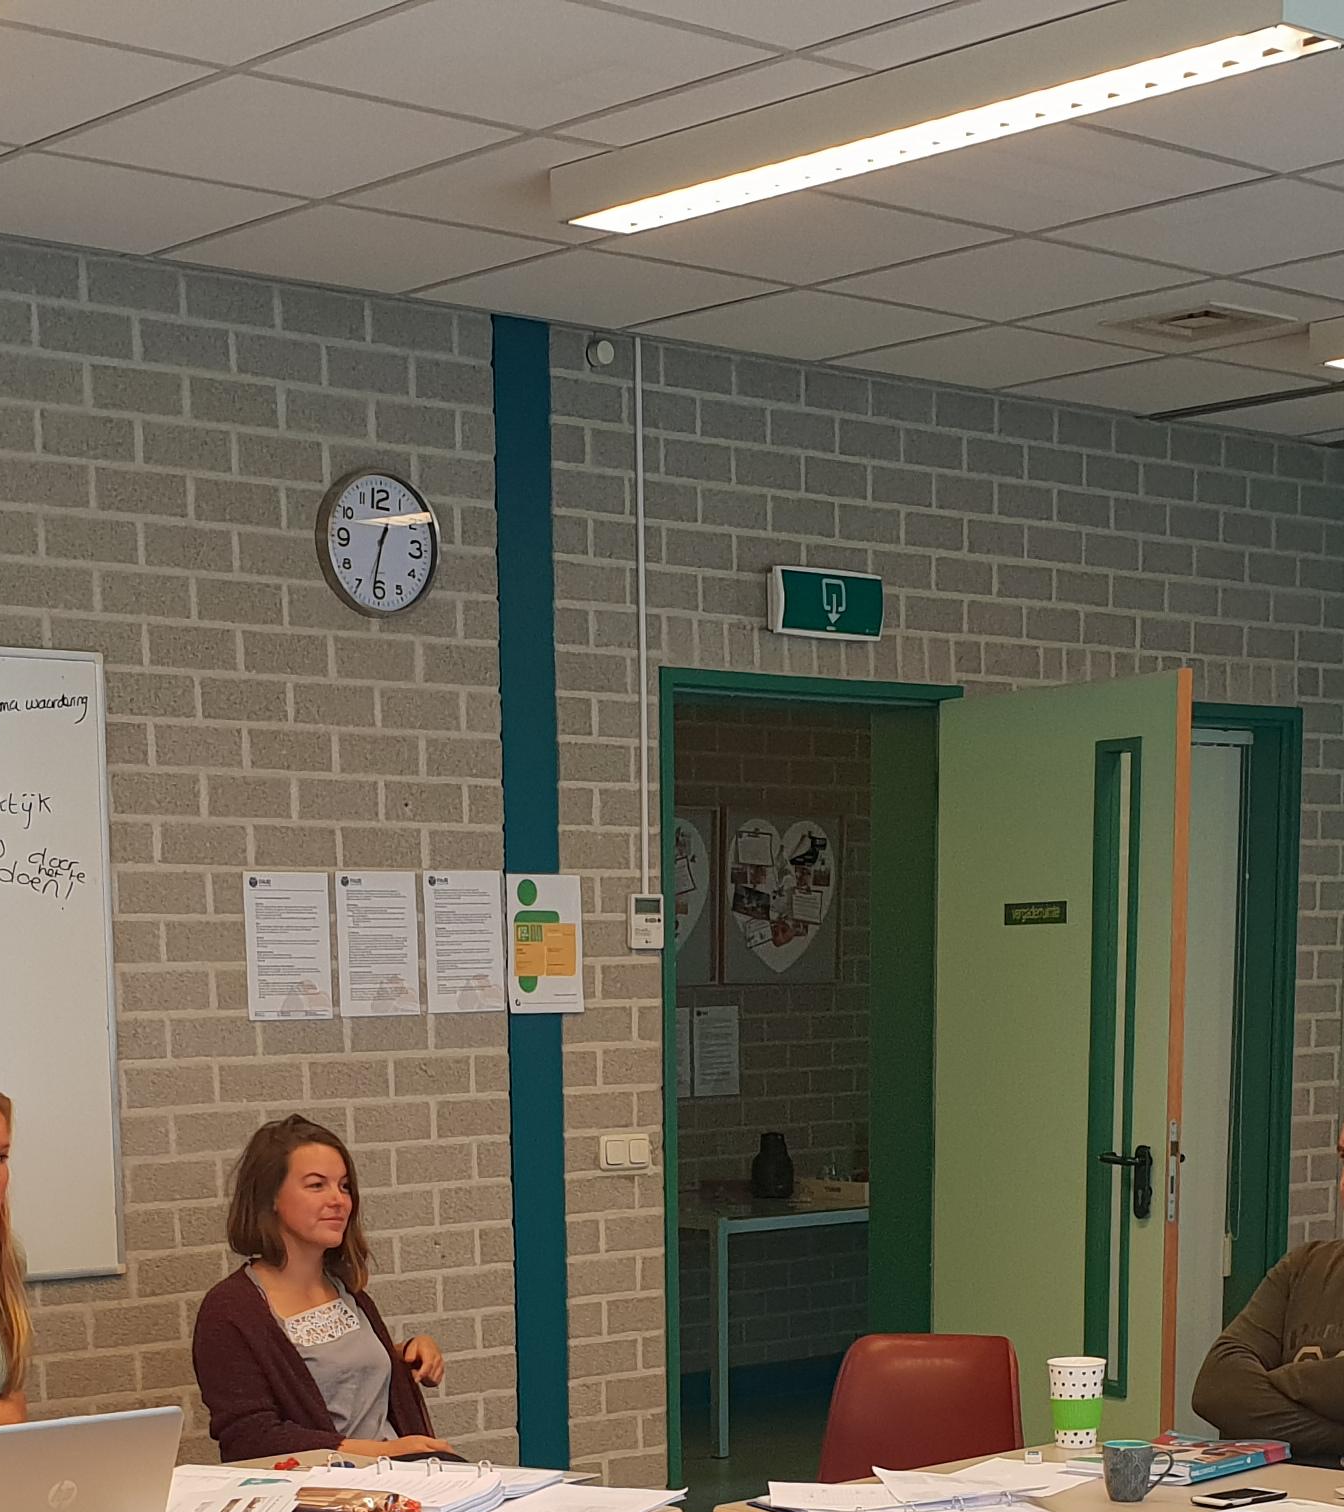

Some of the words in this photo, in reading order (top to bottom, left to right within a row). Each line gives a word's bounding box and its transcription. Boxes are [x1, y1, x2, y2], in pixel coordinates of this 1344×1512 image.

[359, 491, 366, 505] 11
[370, 487, 390, 512] 12
[342, 506, 354, 520] 10
[337, 527, 351, 547] 9
[408, 539, 423, 559] 3
[342, 558, 352, 570] 8
[407, 568, 417, 579] 4
[355, 578, 363, 590] 7
[373, 580, 386, 600] 6
[395, 584, 403, 596] 5
